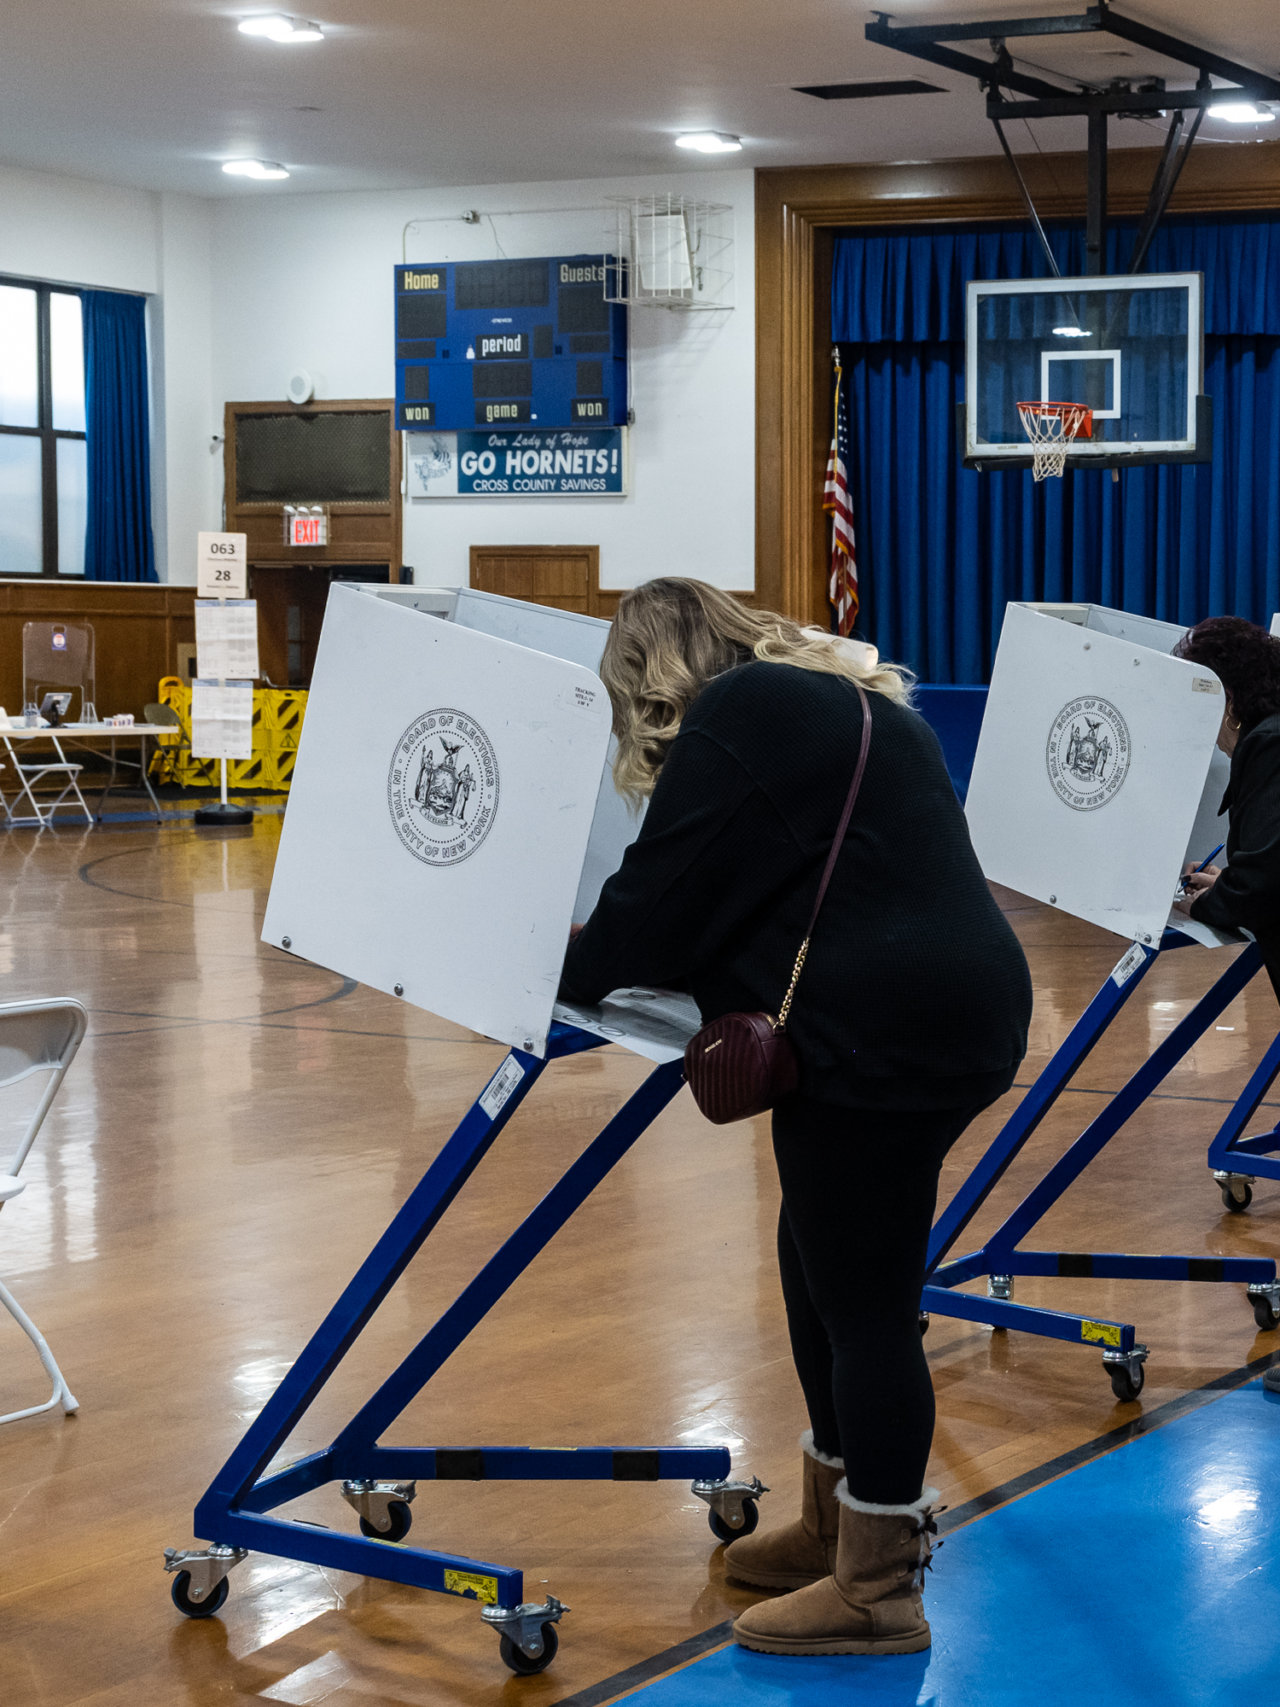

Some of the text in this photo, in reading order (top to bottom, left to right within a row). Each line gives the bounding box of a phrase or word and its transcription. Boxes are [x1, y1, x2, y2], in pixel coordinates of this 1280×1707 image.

[404, 271, 439, 290] Home
[560, 263, 605, 283] Guests
[482, 334, 521, 357] period
[405, 407, 430, 421] won
[486, 404, 518, 423] game
[577, 402, 603, 416] won
[488, 432, 589, 450] Our Lady of Hope
[460, 448, 618, 476] GO HORNETS!
[473, 478, 606, 491] CROSS COUNTY SAVINGS
[295, 520, 320, 544] EXIT
[210, 543, 235, 554] 063
[215, 570, 231, 581] 28
[402, 715, 495, 788] BOARD OF ELECTIONS
[393, 789, 406, 820] THE
[401, 822, 424, 850] CITY
[424, 844, 440, 858] OF
[442, 840, 468, 858] NEW
[468, 804, 492, 843] YORK
